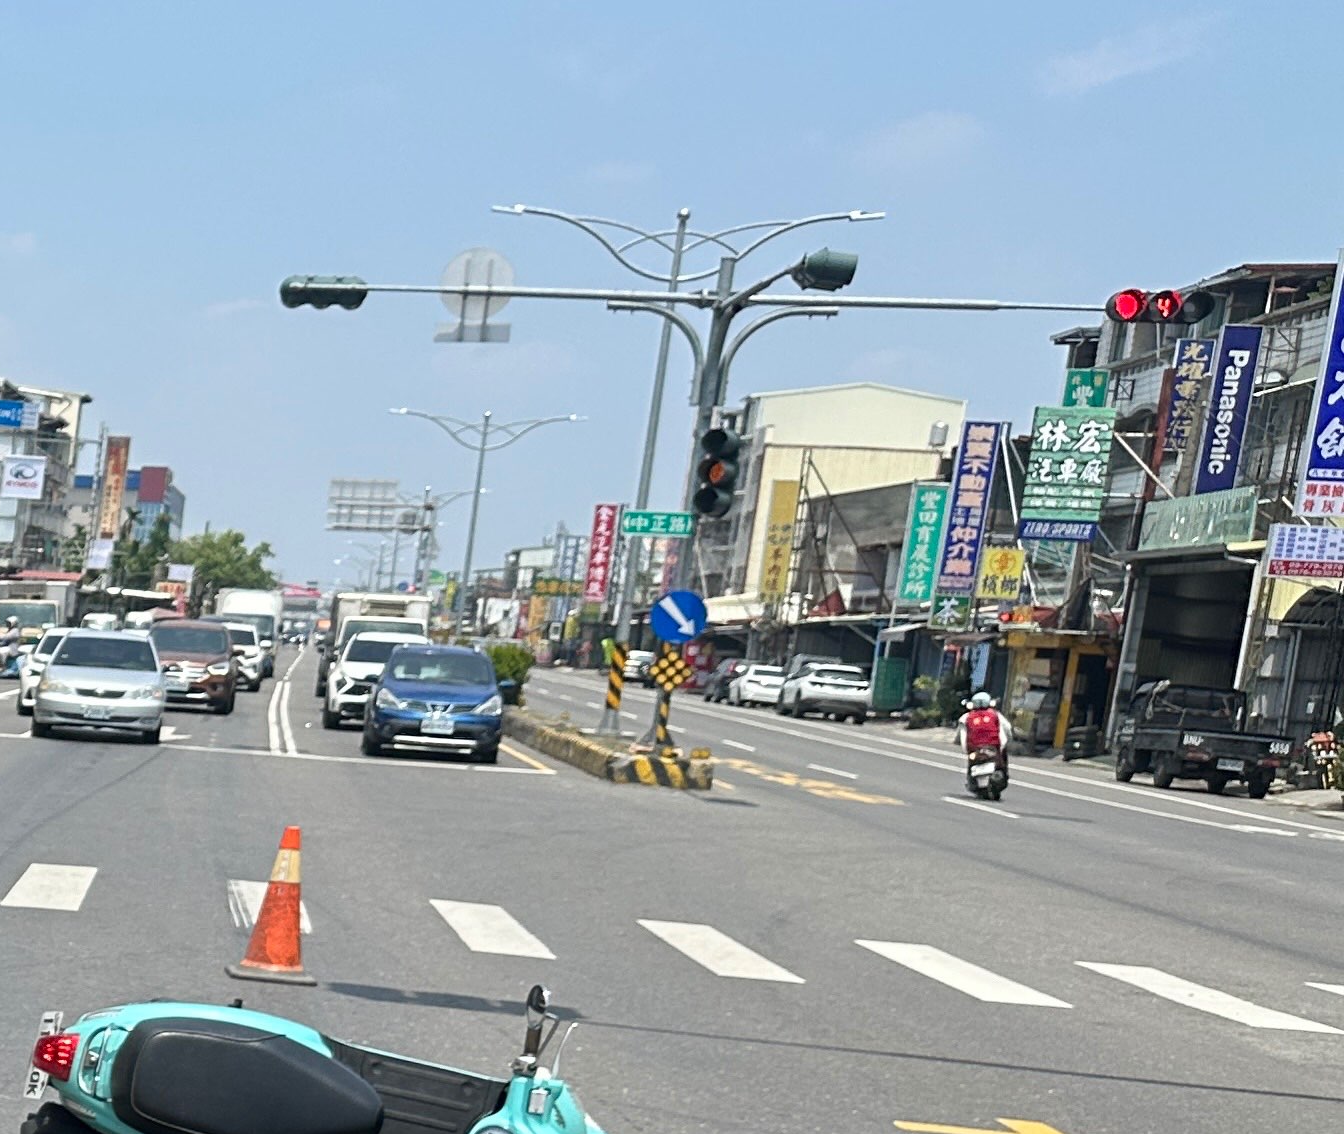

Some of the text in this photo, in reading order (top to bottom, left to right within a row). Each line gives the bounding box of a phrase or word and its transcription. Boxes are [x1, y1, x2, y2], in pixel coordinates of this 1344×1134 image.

[1207, 349, 1252, 476] Panasonic
[631, 514, 687, 533] 中正路
[935, 598, 961, 624] 茶
